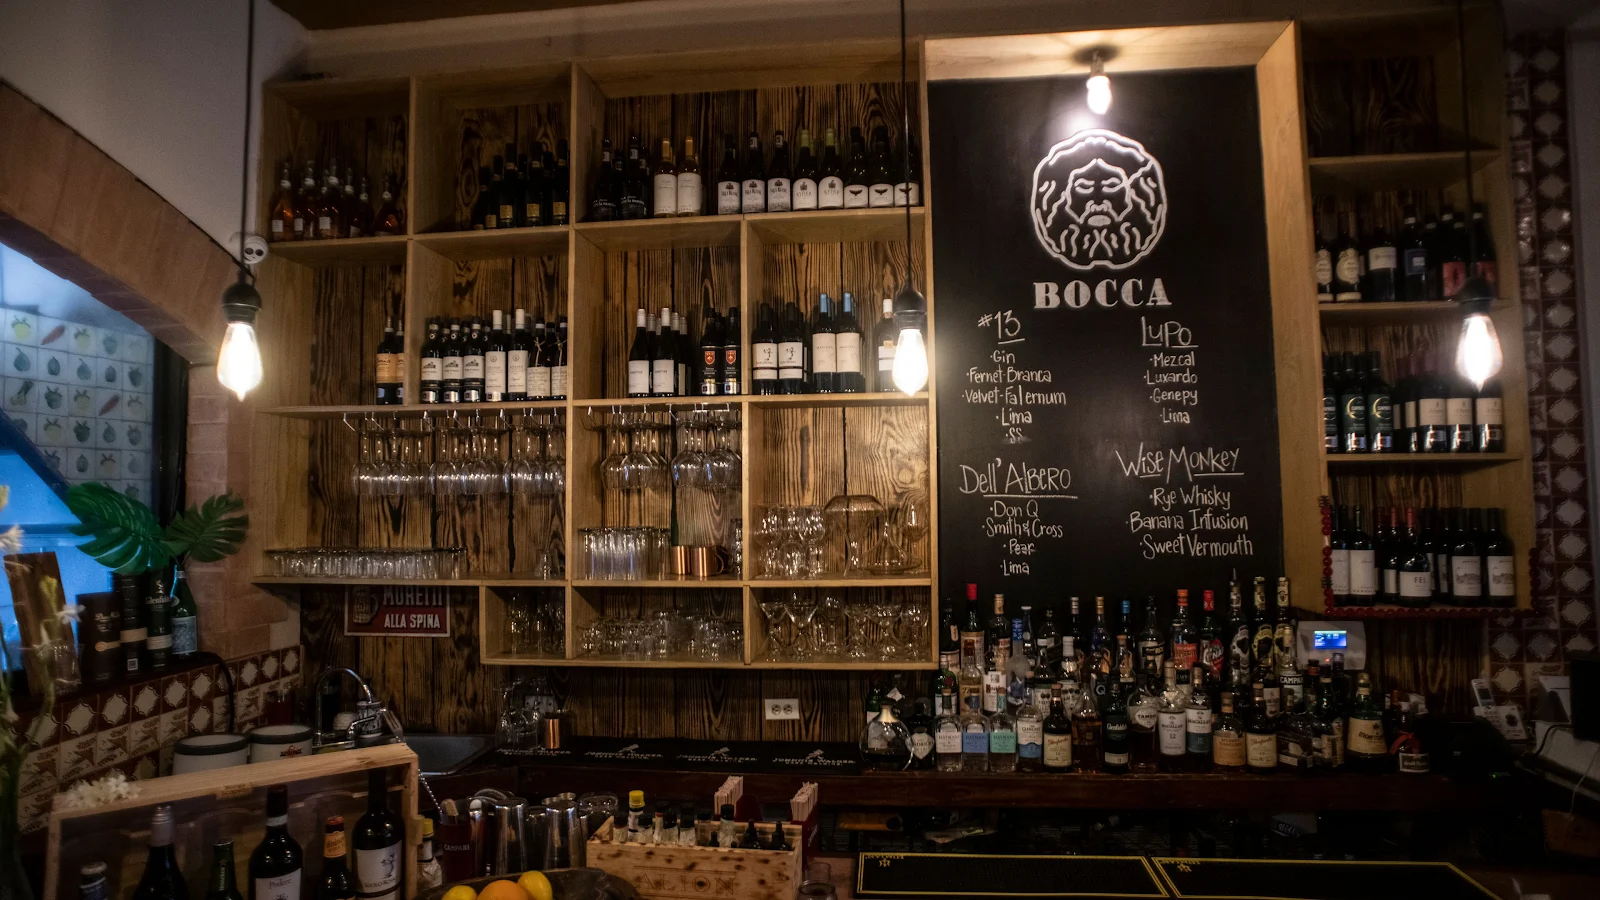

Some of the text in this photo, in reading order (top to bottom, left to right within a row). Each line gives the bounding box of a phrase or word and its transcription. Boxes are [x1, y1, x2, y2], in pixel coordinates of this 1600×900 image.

[1033, 277, 1172, 309] BOCCA
[977, 310, 1021, 339] #13
[993, 350, 1016, 364] Gin
[1153, 351, 1195, 367] Mezcal
[1146, 368, 1198, 385] Luxardo
[1153, 387, 1198, 406] Genepy
[1001, 407, 1032, 426] Lima
[1162, 407, 1190, 424] Lima
[1153, 484, 1231, 511] Rye Whisky
[993, 499, 1038, 518] Don Q
[1129, 507, 1249, 533] Banana Infusion
[1142, 532, 1254, 560] Sweet Vermouth
[1002, 559, 1030, 576] Lima
[383, 613, 441, 629] ALLA SPINA
[443, 843, 471, 852] CAMPARI
